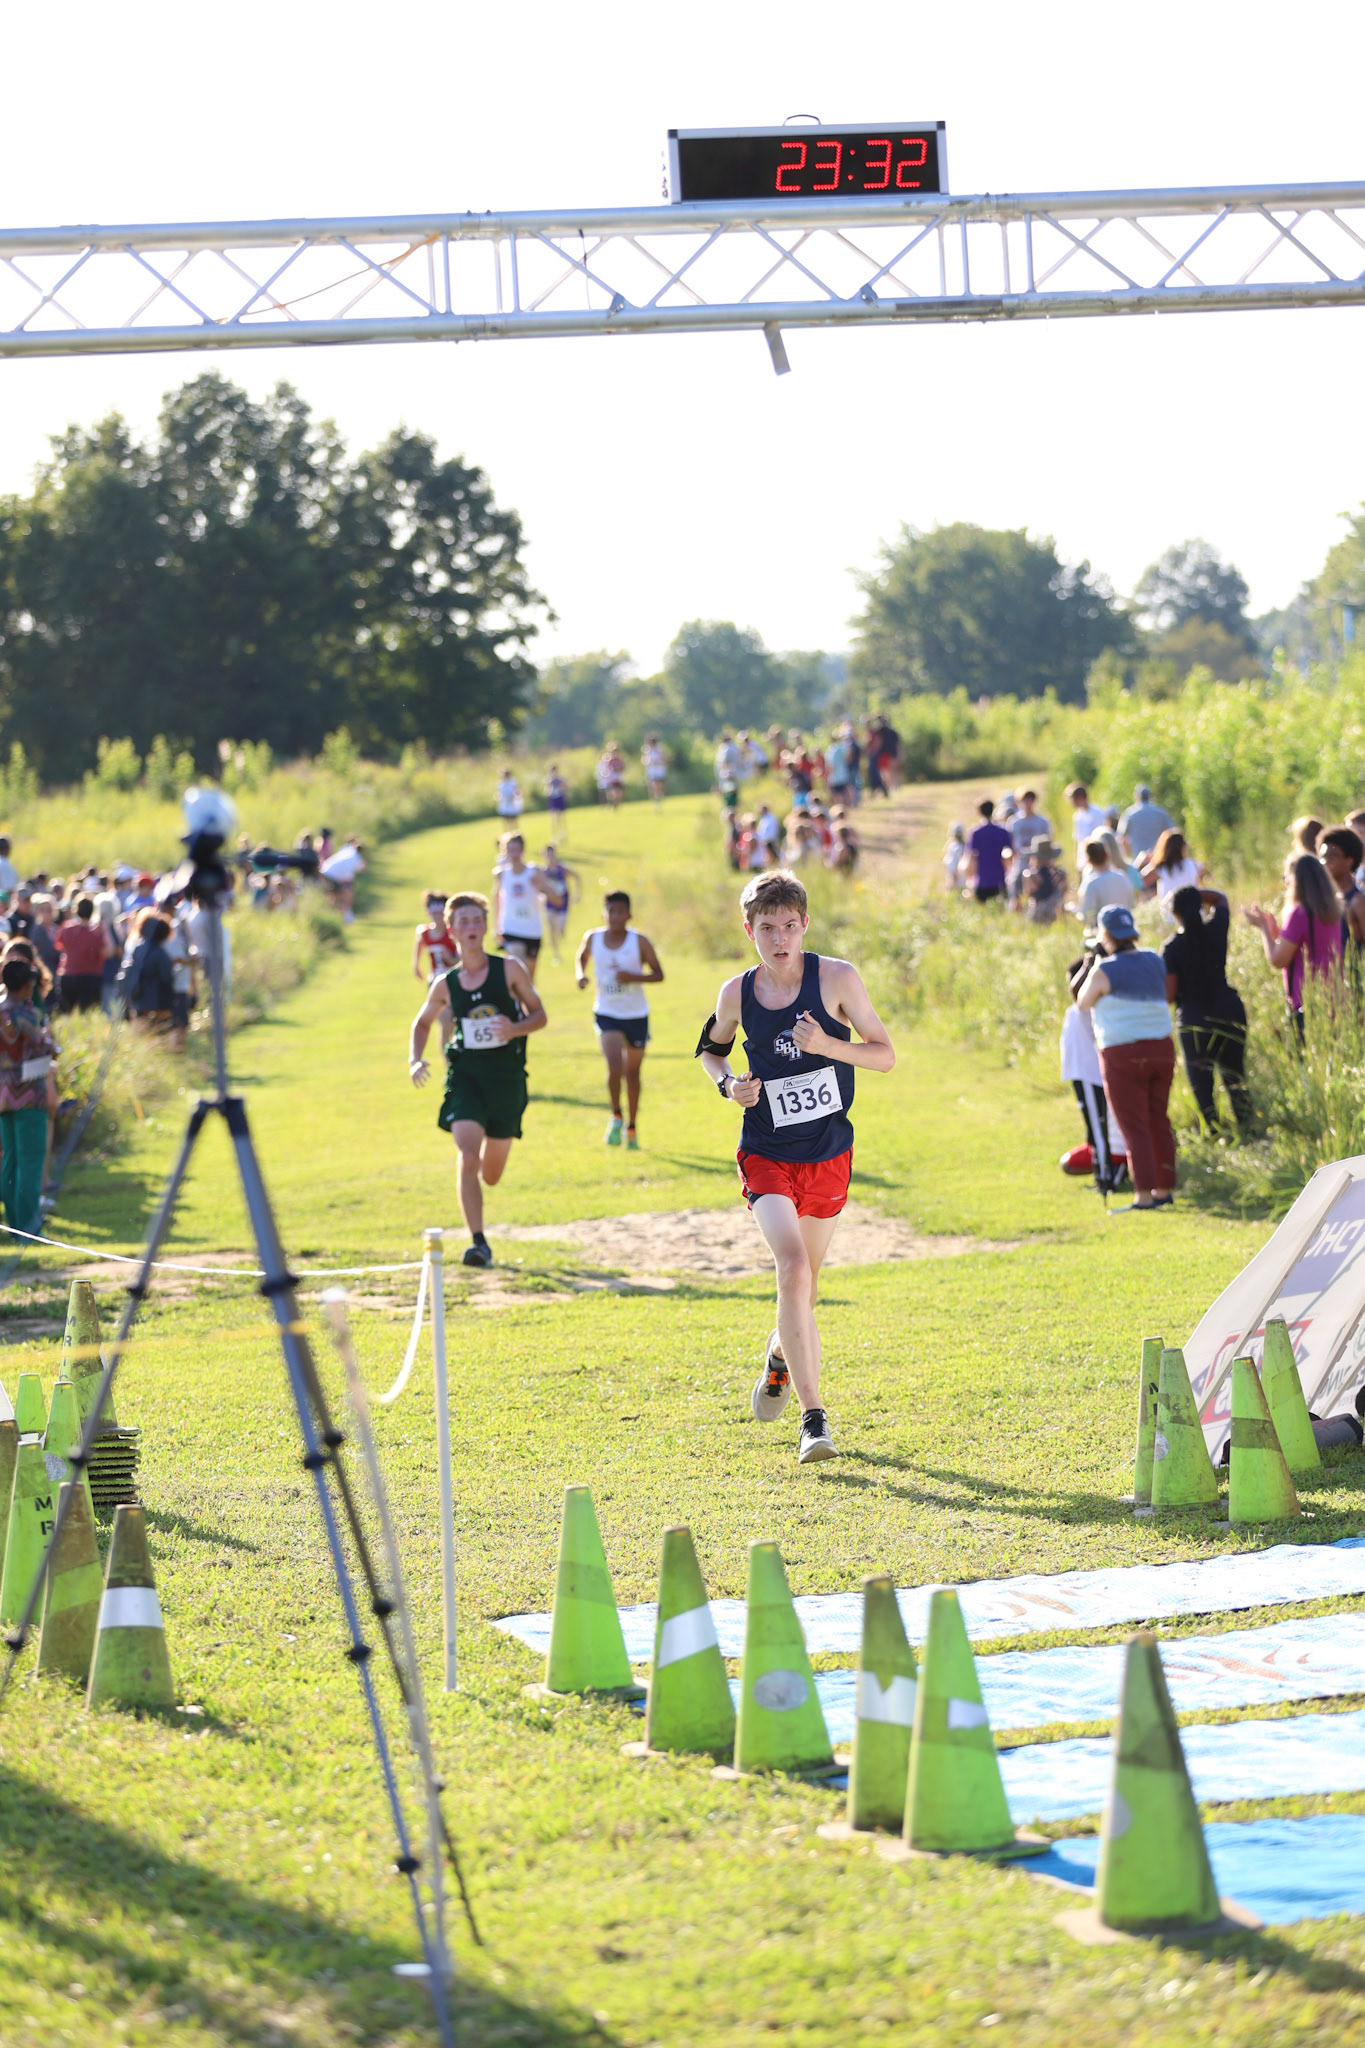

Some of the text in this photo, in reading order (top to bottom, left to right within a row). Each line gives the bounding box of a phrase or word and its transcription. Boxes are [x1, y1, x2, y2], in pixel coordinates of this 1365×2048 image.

[776, 138, 928, 192] 23:32
[775, 1038, 801, 1058] SBA
[776, 1082, 832, 1115] 1336
